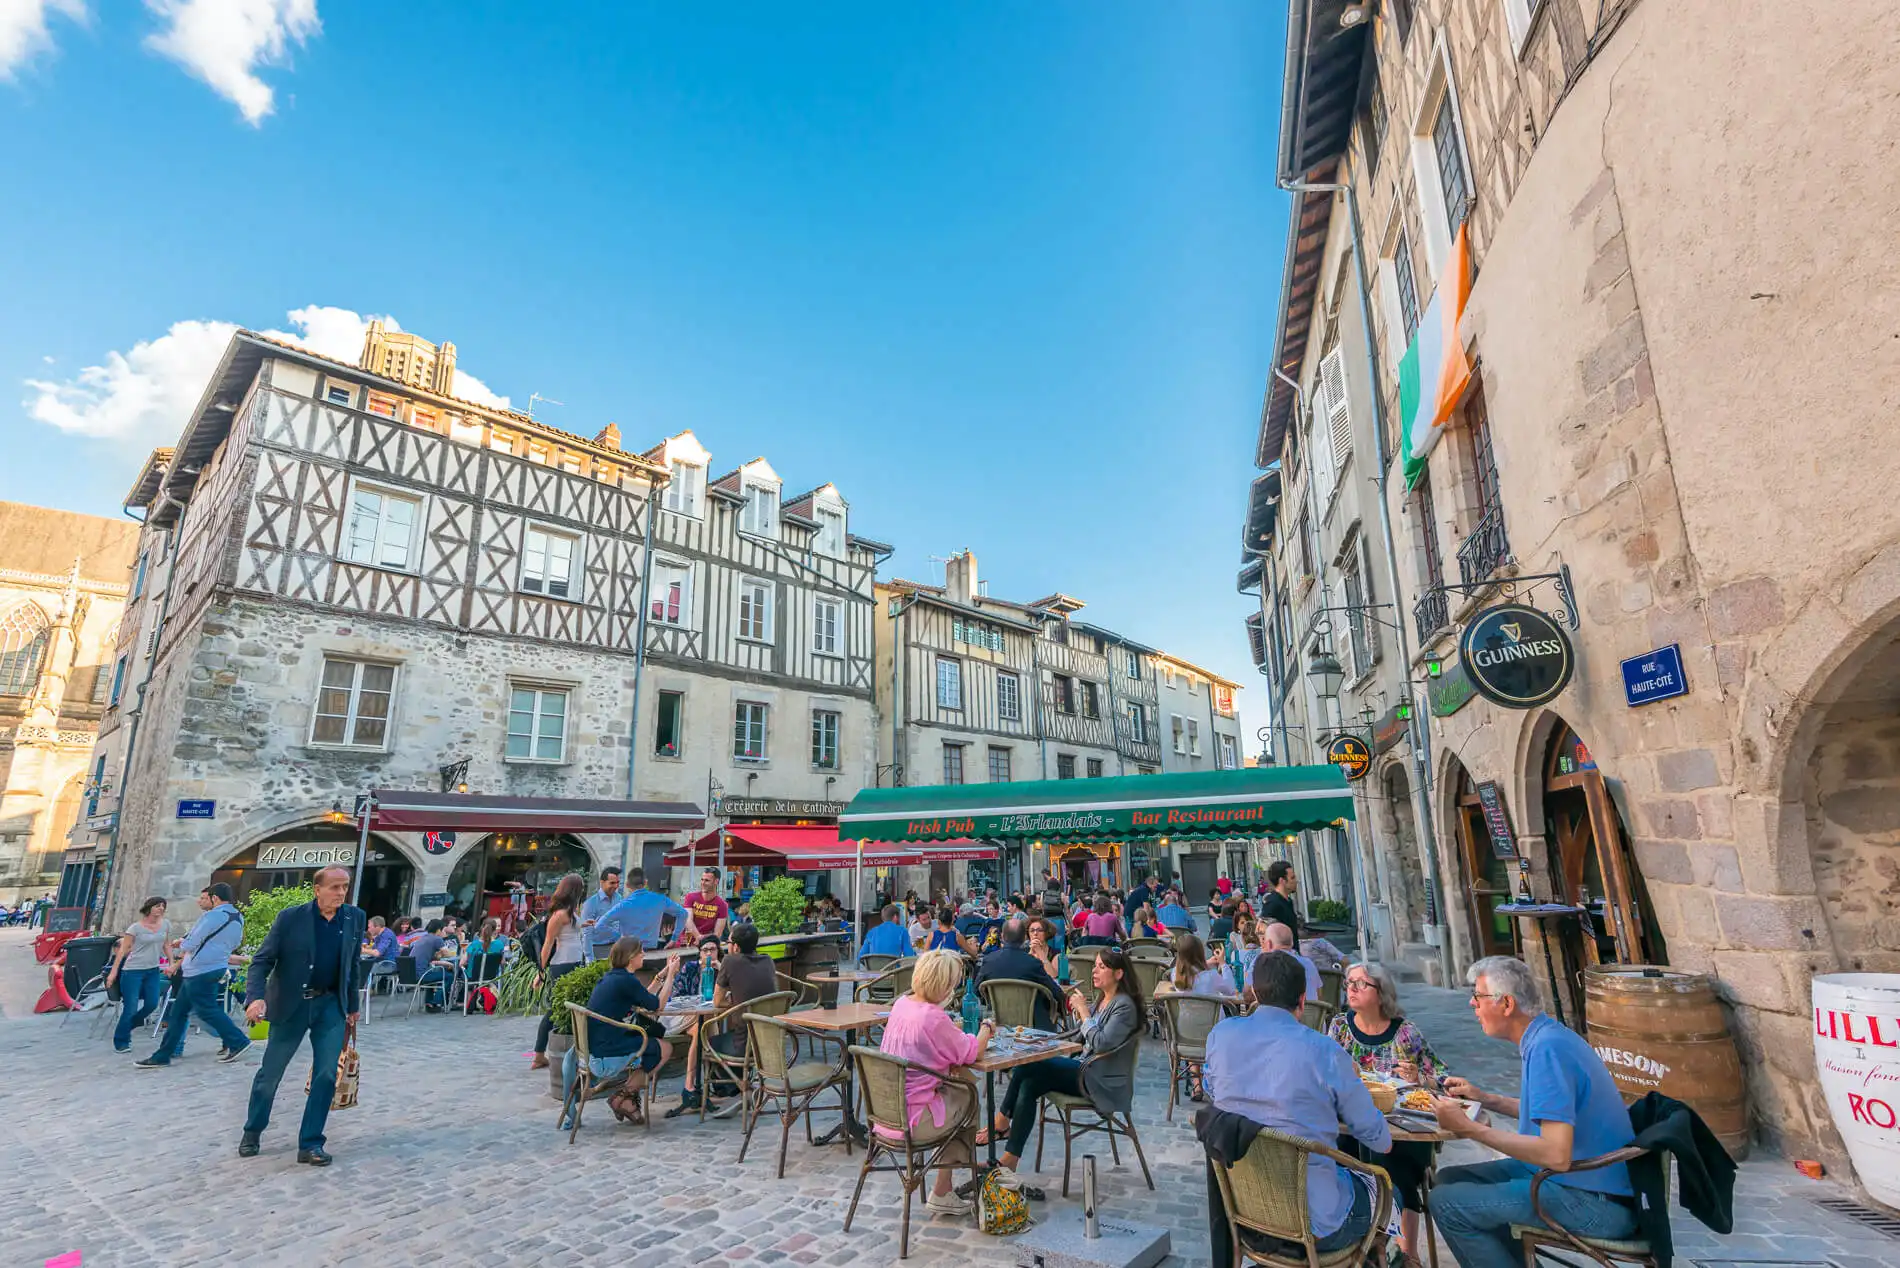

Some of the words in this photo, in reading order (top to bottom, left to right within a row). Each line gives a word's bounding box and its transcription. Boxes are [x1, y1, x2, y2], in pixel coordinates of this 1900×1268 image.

[1475, 639, 1560, 667] GUINNESS
[1642, 662, 1656, 674] RUE
[1631, 672, 1674, 695] HAUTE-CITÉ
[1330, 753, 1368, 761] GUINNESS
[907, 819, 941, 834] Irish
[945, 817, 976, 833] Pub
[1000, 812, 1102, 832] L'Irlandais
[1132, 812, 1163, 825] Bar
[1167, 806, 1265, 823] Restaurant
[260, 846, 299, 865] 4/4
[303, 846, 353, 864] ante
[1815, 1007, 1900, 1049] LILL
[1594, 1046, 1671, 1079] MESON
[1847, 1092, 1900, 1132] RO
